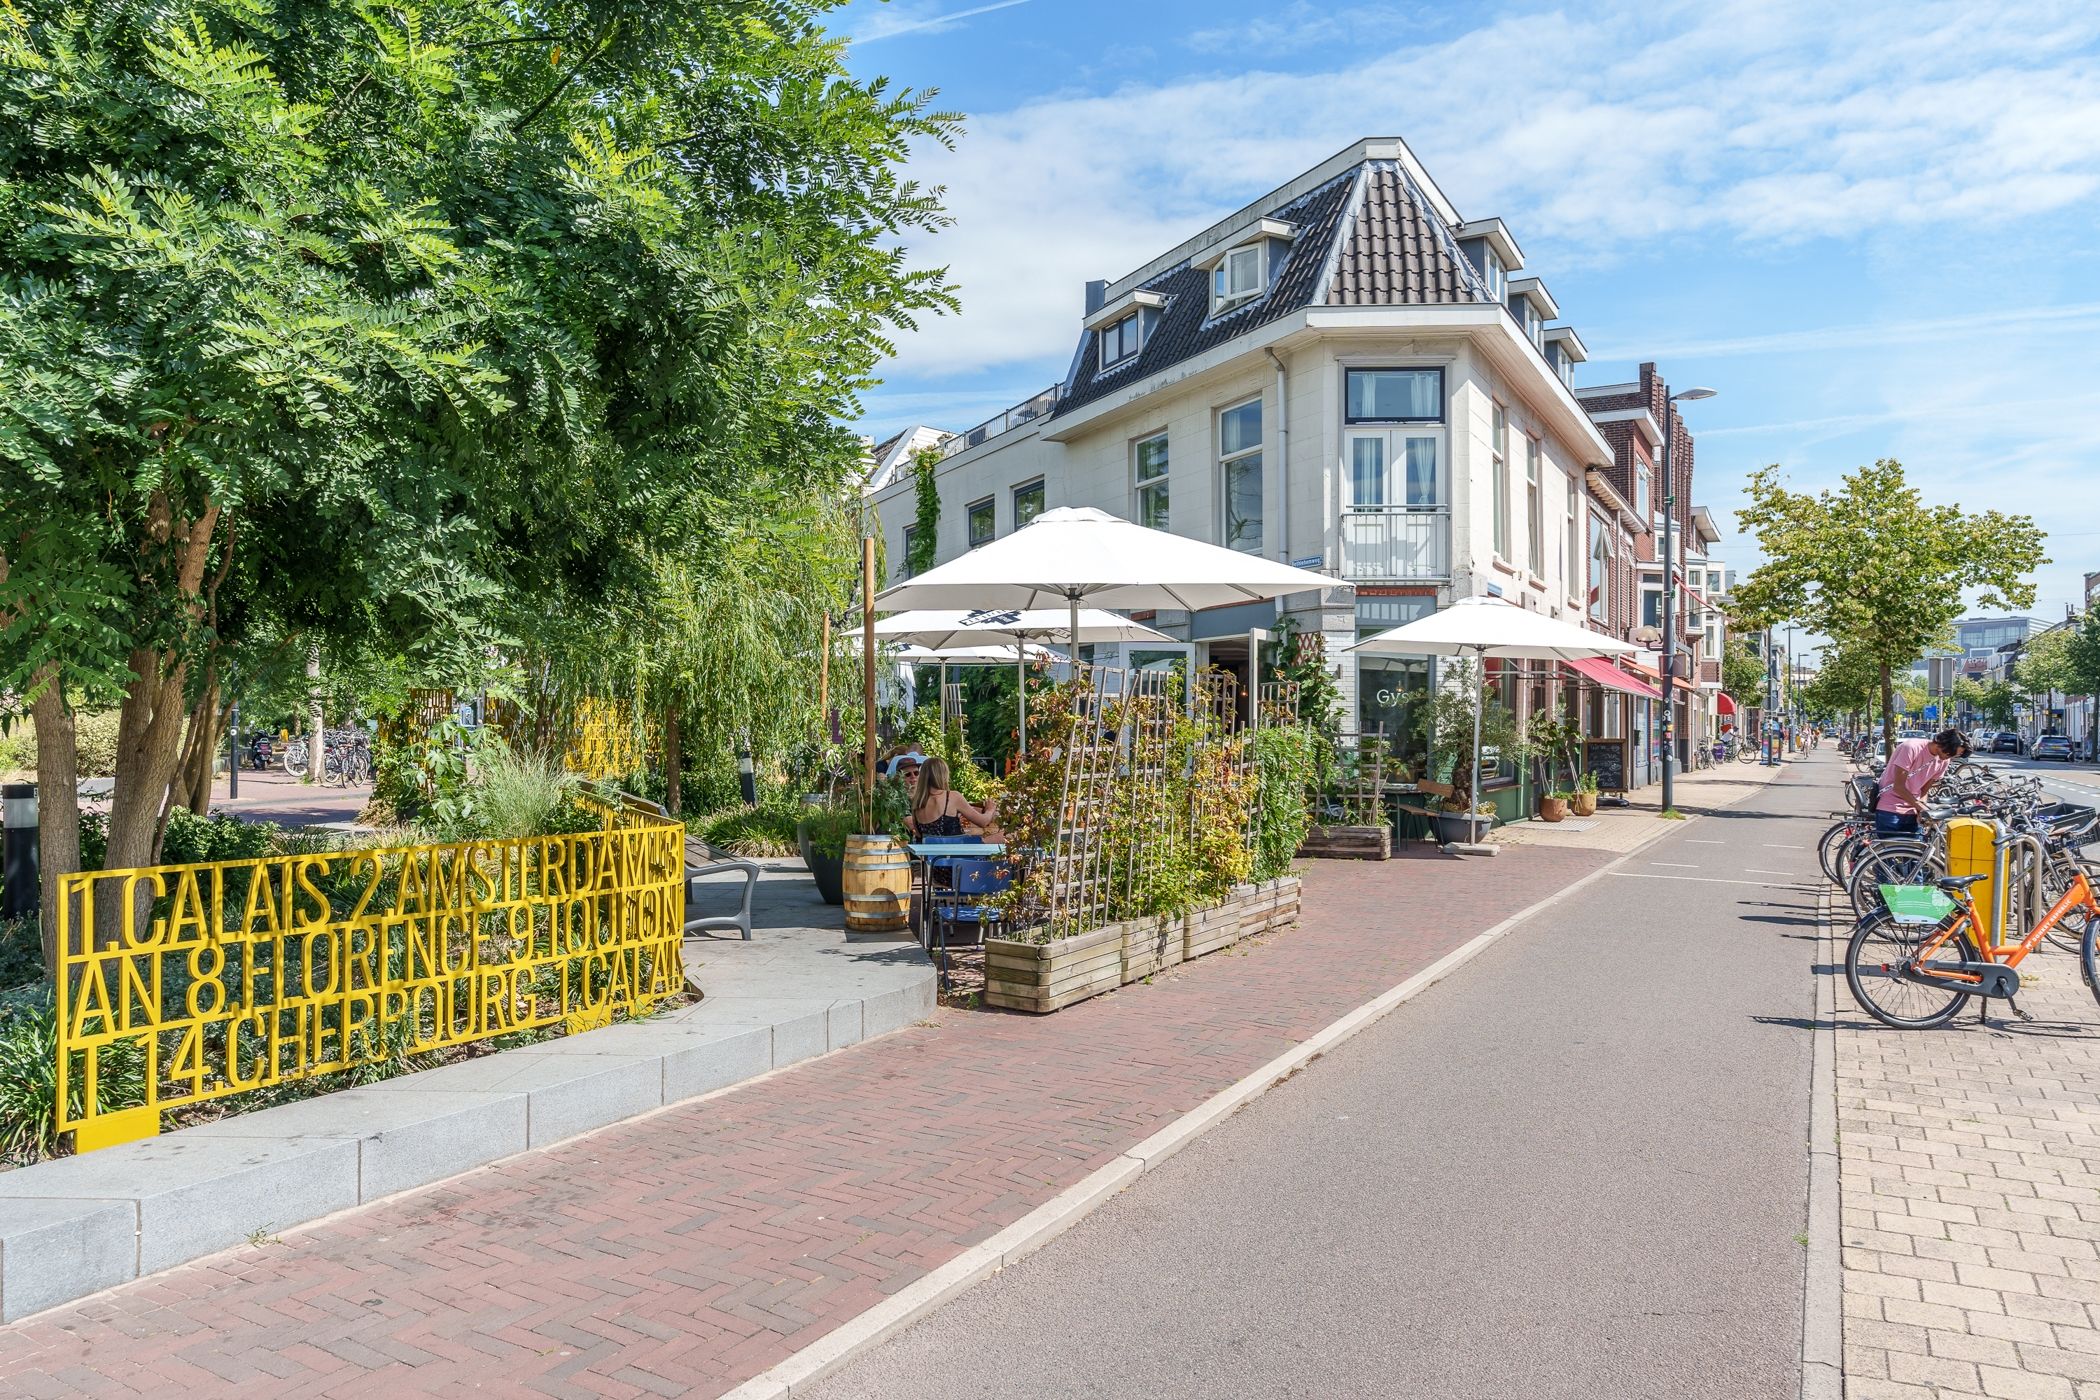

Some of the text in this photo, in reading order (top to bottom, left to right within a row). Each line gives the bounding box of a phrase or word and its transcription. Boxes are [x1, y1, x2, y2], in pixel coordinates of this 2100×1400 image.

[1376, 689, 1409, 707] Gys
[2032, 899, 2072, 942] DONKEY REPUBLIC
[69, 951, 162, 1042] AN
